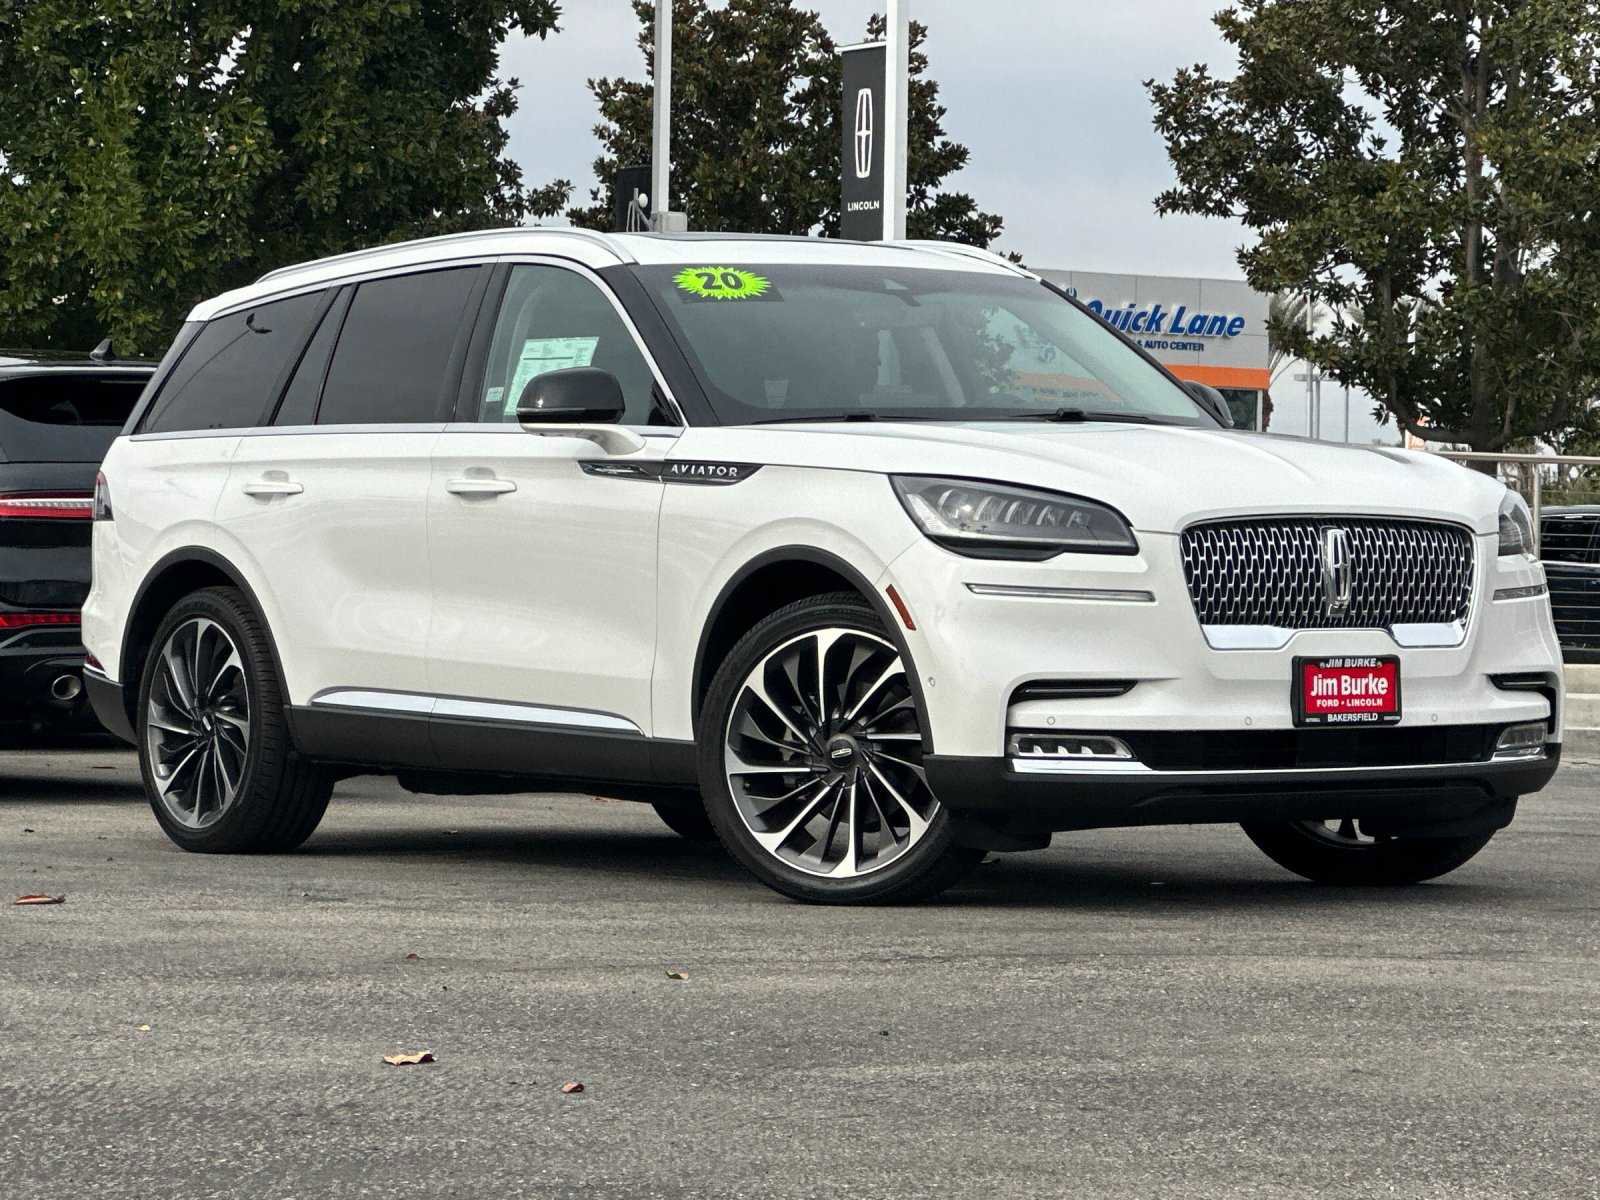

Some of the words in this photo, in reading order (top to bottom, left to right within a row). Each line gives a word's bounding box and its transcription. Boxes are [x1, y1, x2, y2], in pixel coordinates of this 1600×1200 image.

[847, 199, 880, 211] LINCOLN
[695, 271, 743, 291] 20
[1170, 305, 1245, 337] Lane
[1144, 340, 1169, 350] AUTO
[1169, 341, 1204, 352] CENTER
[671, 464, 738, 477] AVIATOR
[1326, 658, 1343, 668] JIM
[1344, 658, 1376, 668] BURKE
[1310, 673, 1338, 696] Jim
[1340, 672, 1388, 695] Burke
[1316, 698, 1340, 708] FORD
[1346, 698, 1383, 707] LINCOLN
[1327, 712, 1378, 722] BAKERSFIELD
